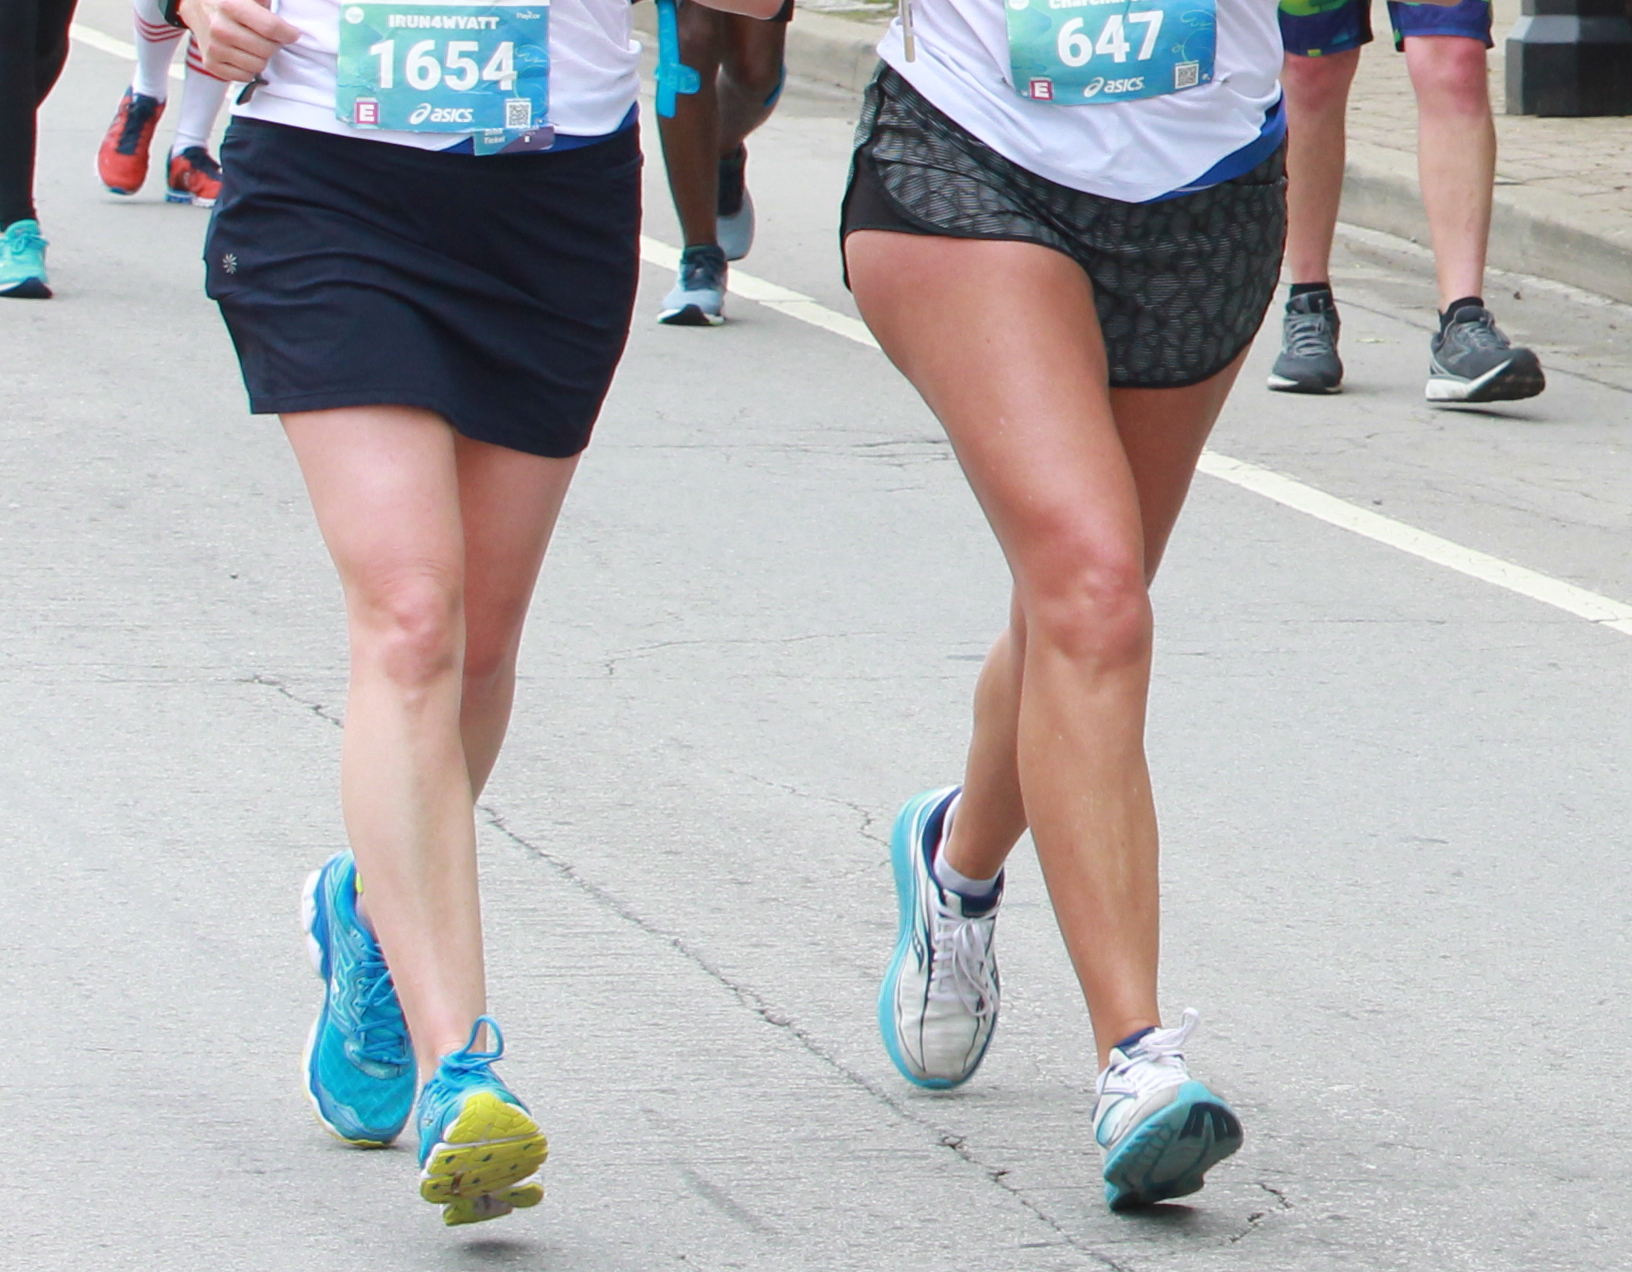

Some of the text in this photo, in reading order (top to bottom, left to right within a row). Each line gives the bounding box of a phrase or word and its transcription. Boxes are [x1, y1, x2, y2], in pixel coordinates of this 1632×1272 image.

[387, 14, 500, 30] IRUN4WYATT
[1057, 10, 1164, 67] 647
[369, 39, 518, 92] 1654
[1034, 82, 1050, 98] E
[359, 104, 375, 123] E
